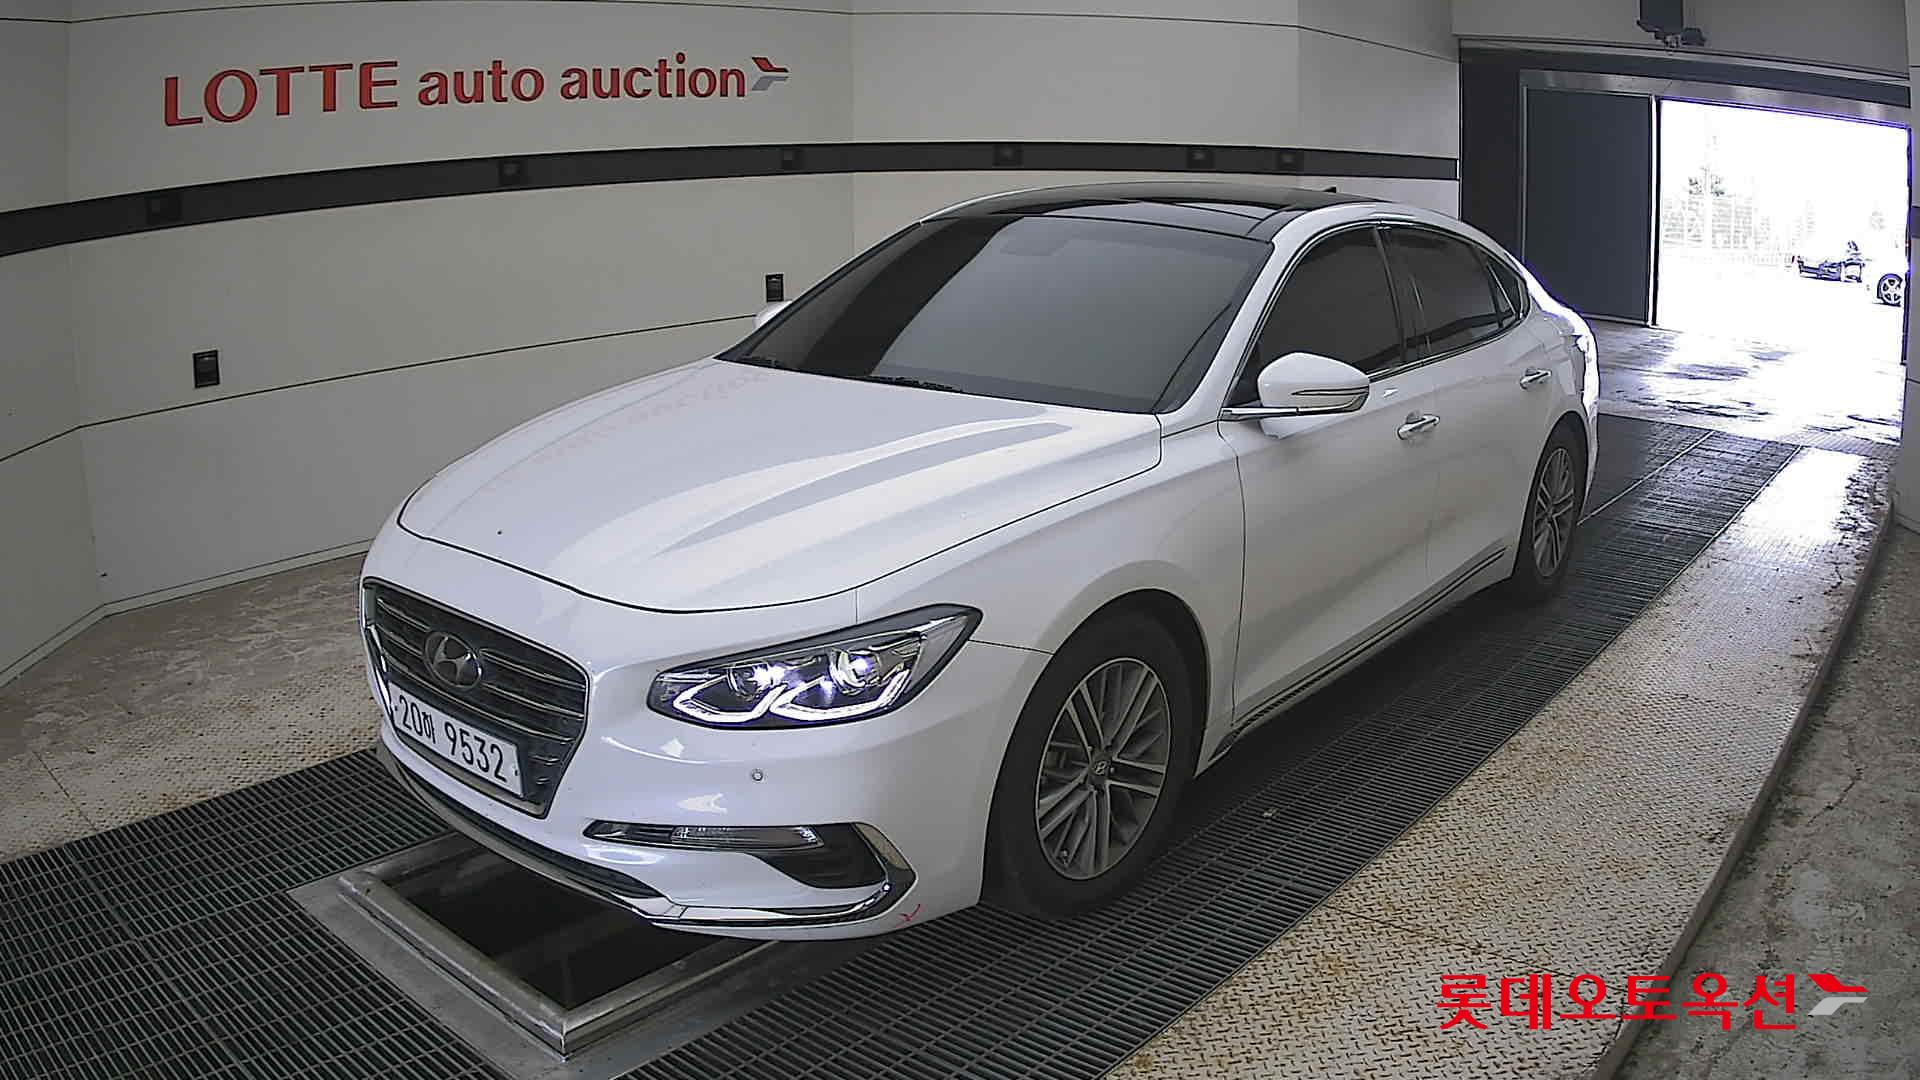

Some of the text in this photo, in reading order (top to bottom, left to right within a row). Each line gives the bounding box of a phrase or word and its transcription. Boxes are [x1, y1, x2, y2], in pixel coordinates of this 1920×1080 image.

[164, 52, 746, 126] LOTTE auto auction
[444, 721, 507, 782] 9532
